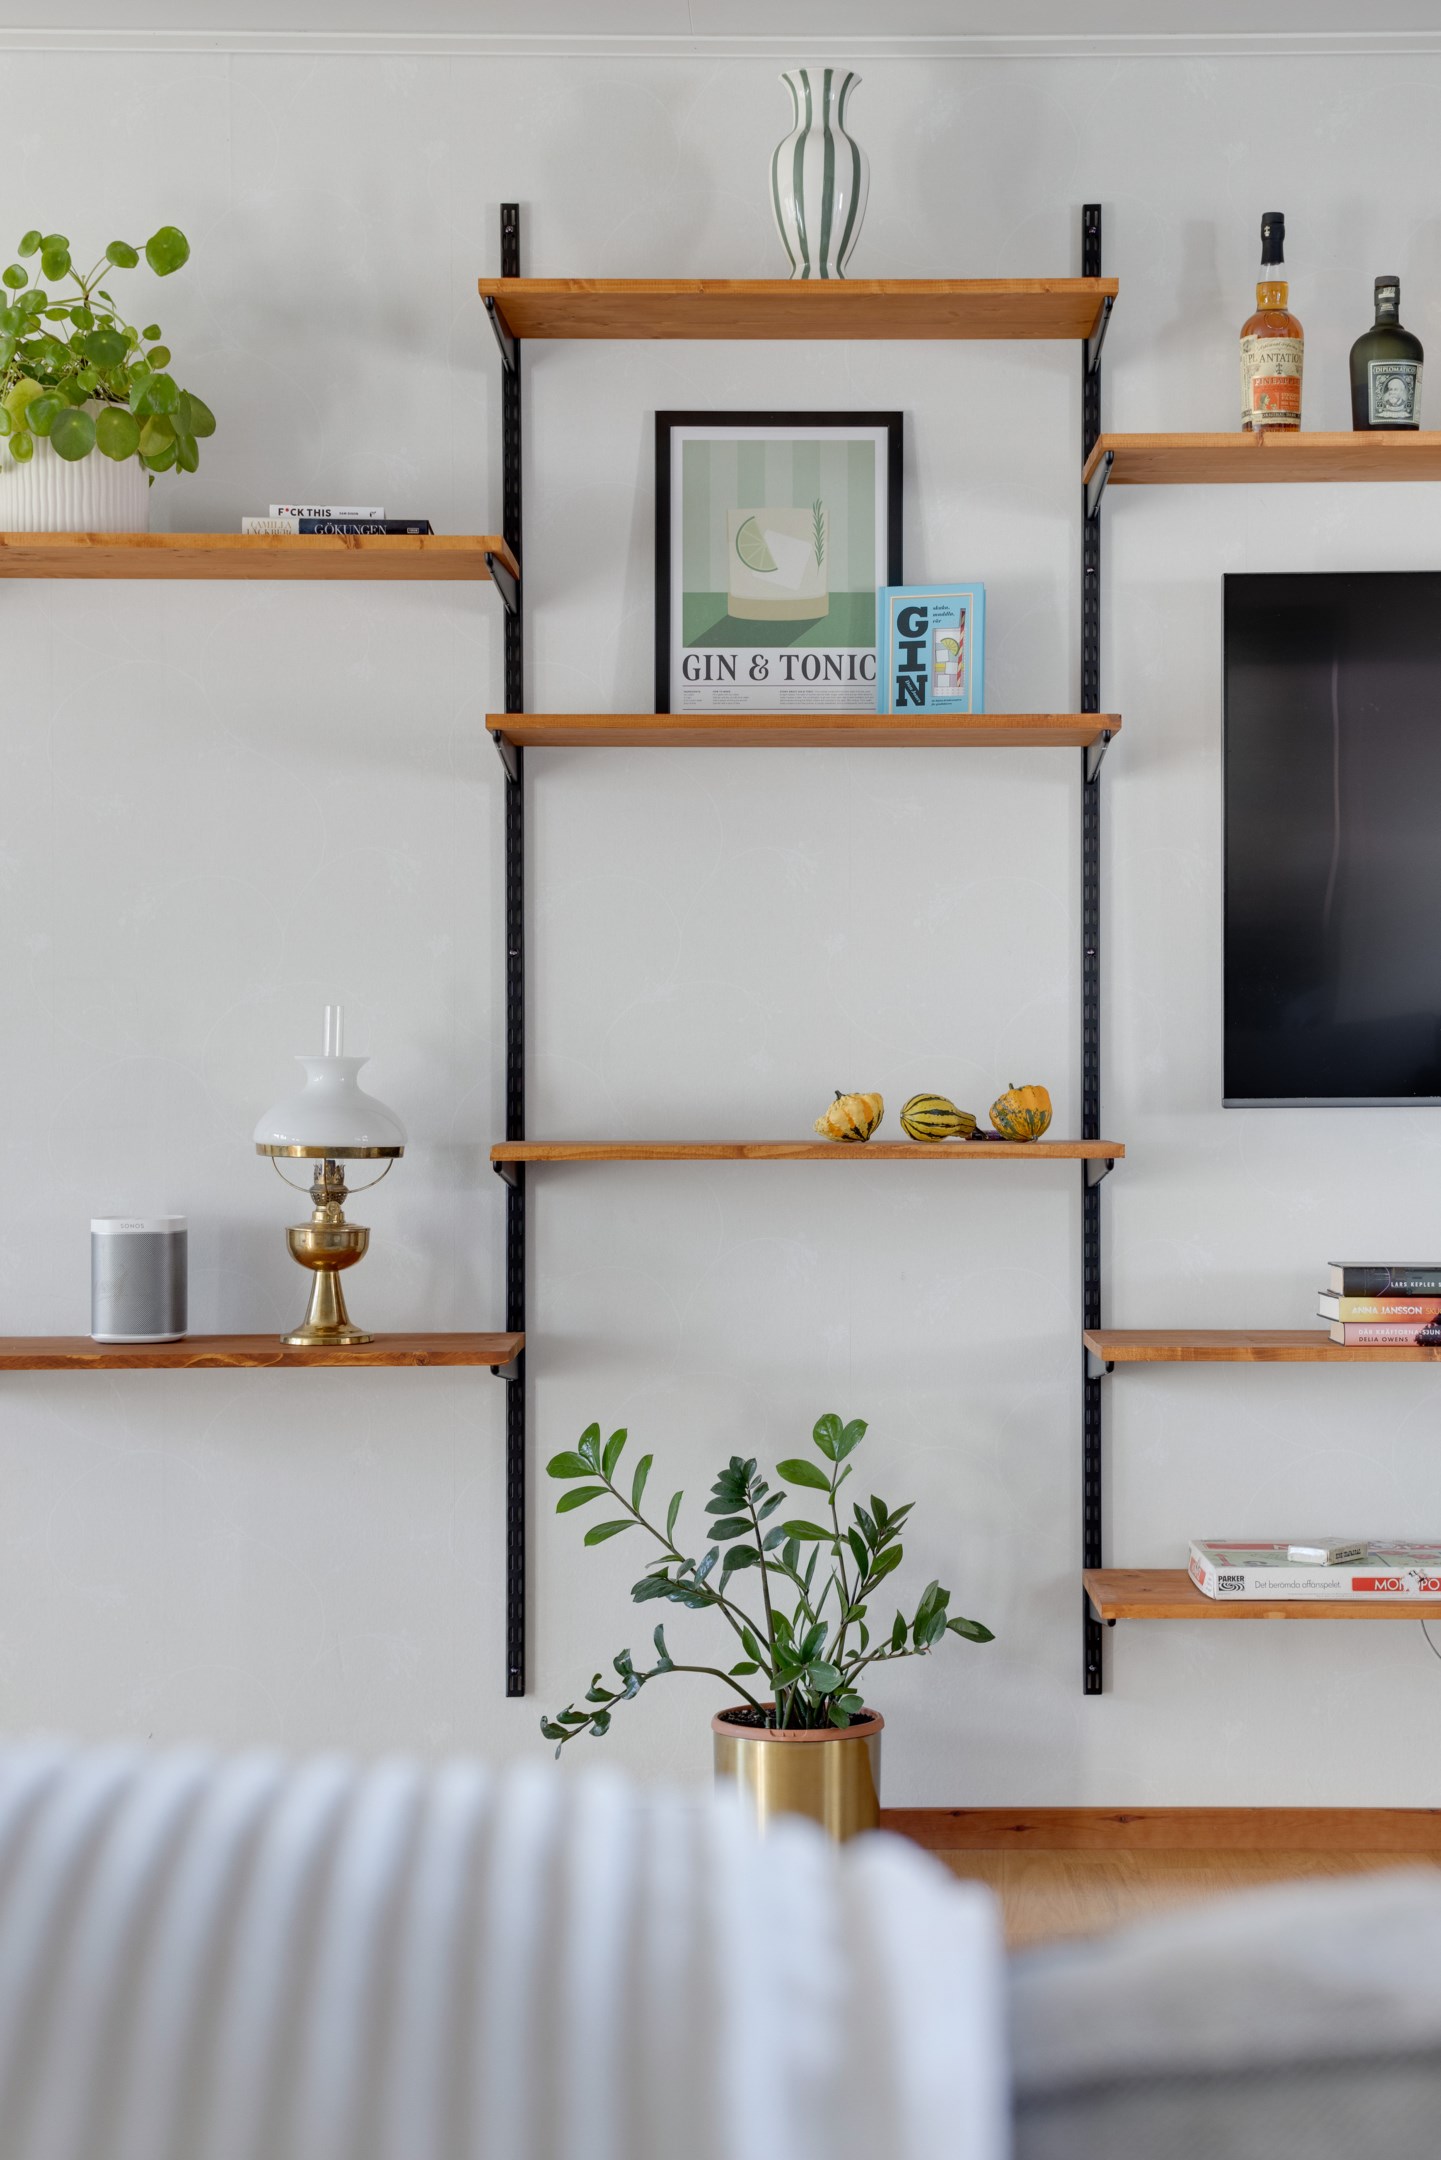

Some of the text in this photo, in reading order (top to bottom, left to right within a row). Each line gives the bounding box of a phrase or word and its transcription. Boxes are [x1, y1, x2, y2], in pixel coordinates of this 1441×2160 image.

[307, 508, 332, 517] THIS
[314, 523, 387, 535] GÖKUNGEN
[896, 606, 929, 707] GIN
[682, 653, 877, 681] GIN & TONIC
[1351, 1306, 1378, 1315] ANNA
[1381, 1306, 1423, 1315] JANSSON
[1254, 1580, 1267, 1589] Det
